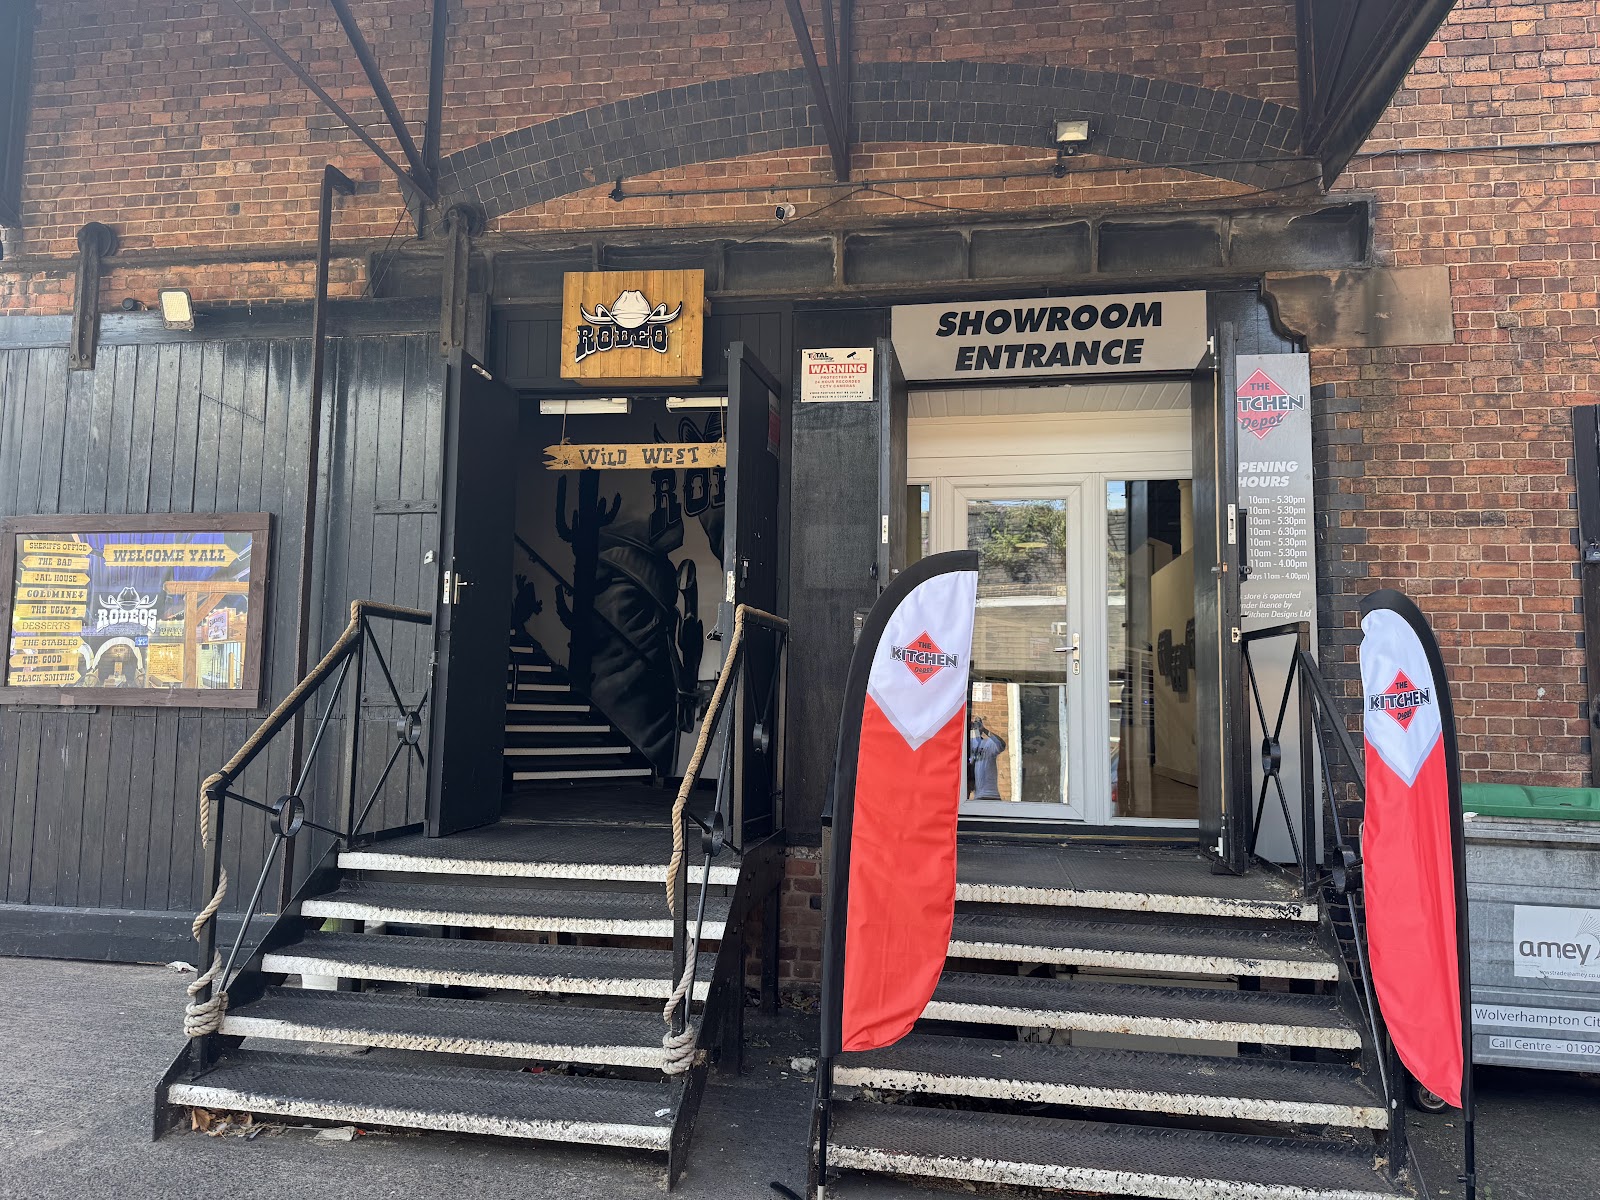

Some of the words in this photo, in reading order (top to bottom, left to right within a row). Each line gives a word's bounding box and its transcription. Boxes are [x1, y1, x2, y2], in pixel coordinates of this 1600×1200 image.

[936, 302, 1162, 337] SHOWROOM
[575, 325, 668, 363] RODEO
[955, 338, 1145, 371] ENTRANCE
[811, 364, 866, 374] WARNING
[1237, 395, 1304, 411] TCHEN
[1241, 413, 1283, 431] Depot
[642, 446, 699, 464] WEST
[1238, 461, 1299, 473] PENING
[1238, 475, 1290, 488] HOURS
[1249, 496, 1270, 504] 10am
[1277, 496, 1306, 505] 5.30pm
[1249, 506, 1270, 514] 10am
[1277, 506, 1306, 516] 5.30pm
[1249, 517, 1270, 525] 10am
[1277, 517, 1306, 526] 5.30pm
[1249, 528, 1271, 536] 10am
[1278, 527, 1306, 537] 6.30pm
[1250, 538, 1271, 546] 10am
[1278, 538, 1307, 548] 5.30pm
[113, 550, 184, 562] WELCOME
[189, 549, 226, 562] YALL
[1250, 549, 1271, 557] 10am
[1278, 549, 1307, 558] 5.30pm
[57, 558, 72, 566] BAD
[1278, 560, 1308, 569] 4.00pm
[54, 574, 77, 582] HOUSE
[1285, 572, 1310, 580] 4.00pm)
[27, 590, 78, 598] GOLDMINE
[1270, 591, 1301, 600] operated
[32, 606, 47, 614] THE
[50, 606, 70, 614] UGLY
[1284, 601, 1292, 609] by
[1271, 610, 1298, 619] Designs
[96, 609, 158, 633] RODEOS
[918, 641, 932, 649] THE
[22, 656, 38, 664] THE
[42, 655, 62, 663] GOOD
[890, 645, 959, 668] KITCHEN
[17, 674, 41, 682] BLACK
[44, 673, 74, 681] SMITHS
[1395, 681, 1408, 689] THE
[1369, 687, 1431, 711] KITCHEN
[1519, 940, 1592, 965] amey
[1474, 1008, 1580, 1026] Wolverhampton
[1584, 1016, 1600, 1027] Cit
[1491, 1038, 1511, 1049] Call
[1514, 1039, 1552, 1051] Centre
[1566, 1043, 1600, 1055] 01902
